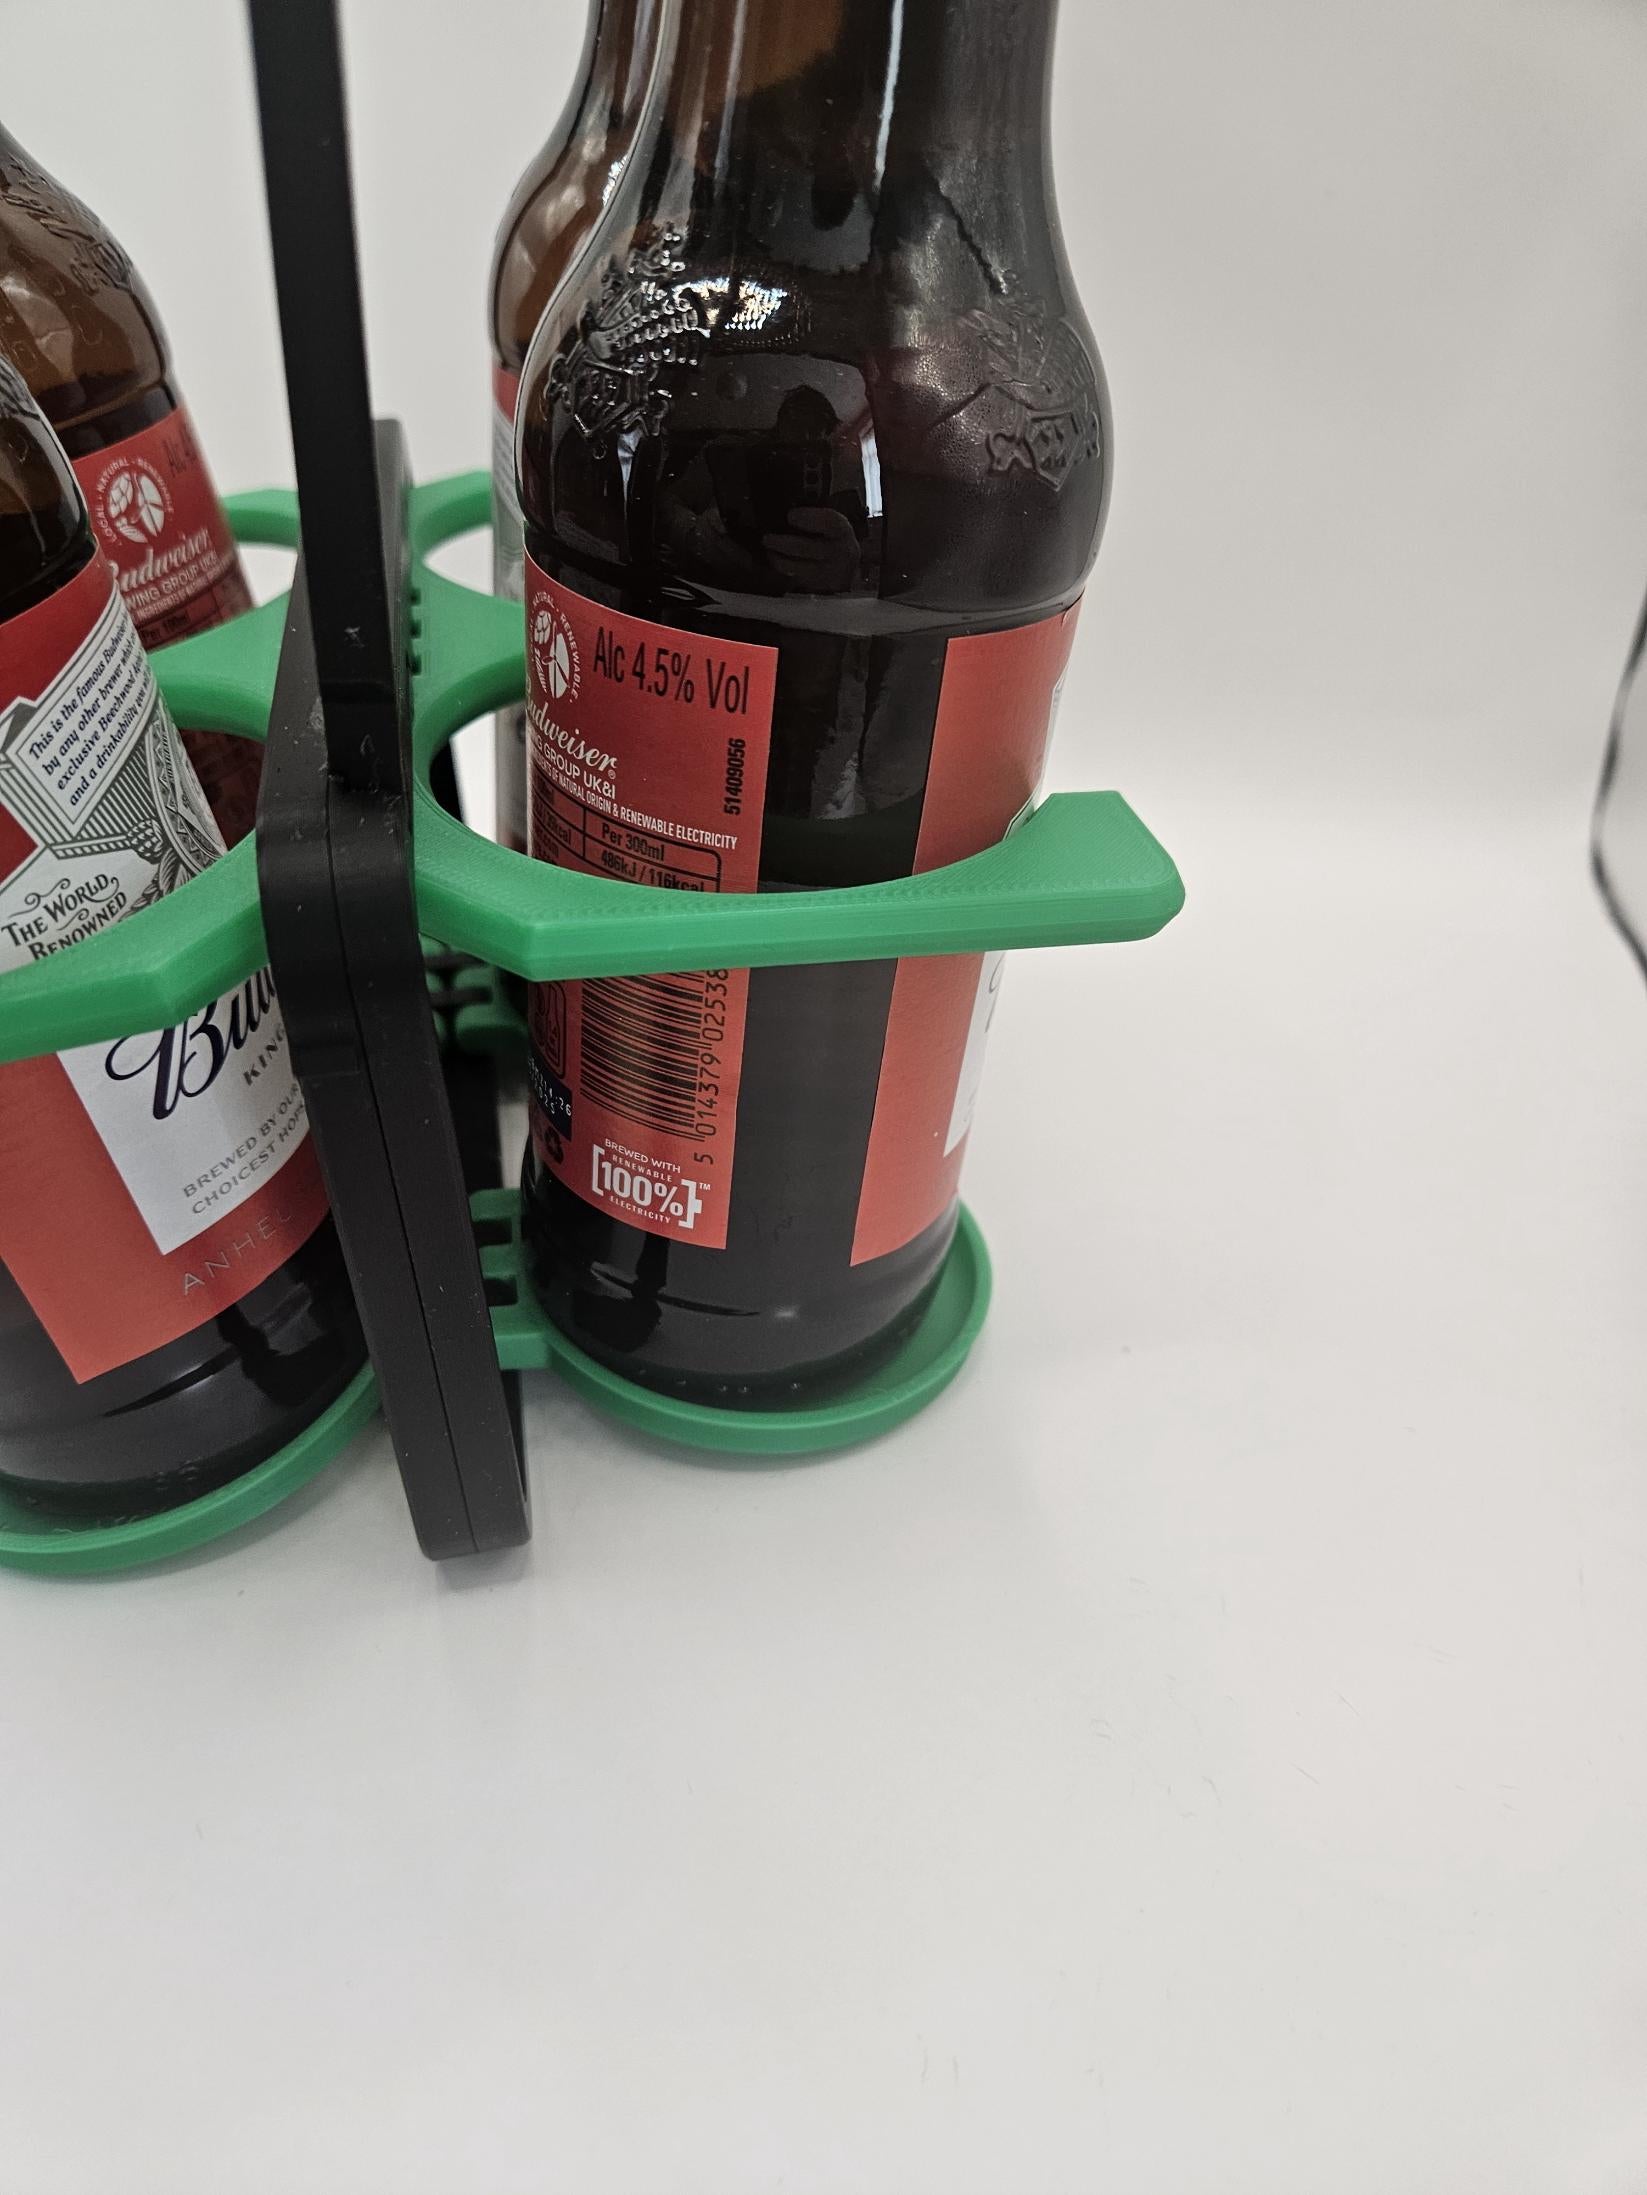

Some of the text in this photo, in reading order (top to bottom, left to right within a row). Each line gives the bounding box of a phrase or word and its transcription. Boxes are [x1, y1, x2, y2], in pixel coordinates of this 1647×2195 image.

[162, 564, 199, 594] GROUP
[560, 614, 581, 700] RENEWABLE
[593, 626, 625, 683] Alc
[632, 642, 695, 704] 4.5%
[706, 658, 749, 715] Vol
[29, 731, 54, 760] This
[51, 720, 64, 733] is
[60, 698, 78, 721] the
[76, 663, 105, 702] famous
[42, 758, 60, 776] by
[60, 729, 81, 757] any
[78, 699, 101, 731] other
[98, 665, 124, 701] brewer
[57, 731, 101, 791] exclusive
[70, 777, 92, 806] and
[89, 768, 98, 780] a
[95, 706, 139, 769] drinkability
[543, 743, 581, 779] GROUP
[583, 771, 616, 800] UK&I
[724, 737, 746, 816] 51409056
[558, 772, 585, 802] NATURAL
[586, 791, 611, 813] ORIGIN
[613, 803, 619, 818] &
[620, 807, 673, 835] RENEWABLE
[676, 824, 737, 849] ELECTRICITY
[602, 823, 664, 861] Per 300ml
[1, 874, 117, 947] THE WORLD
[28, 892, 127, 960] RENOWNED
[243, 1021, 286, 1087] KING
[695, 1053, 721, 1136] 014379
[182, 1135, 258, 1198] BREWED
[259, 1112, 278, 1136] BY
[191, 1142, 276, 1215] CHOICEST
[605, 1138, 681, 1174] BREWED WITH
[612, 1155, 673, 1182] RENEWABLE
[694, 1152, 714, 1165] 5
[610, 1195, 671, 1224] ELECTRICITY
